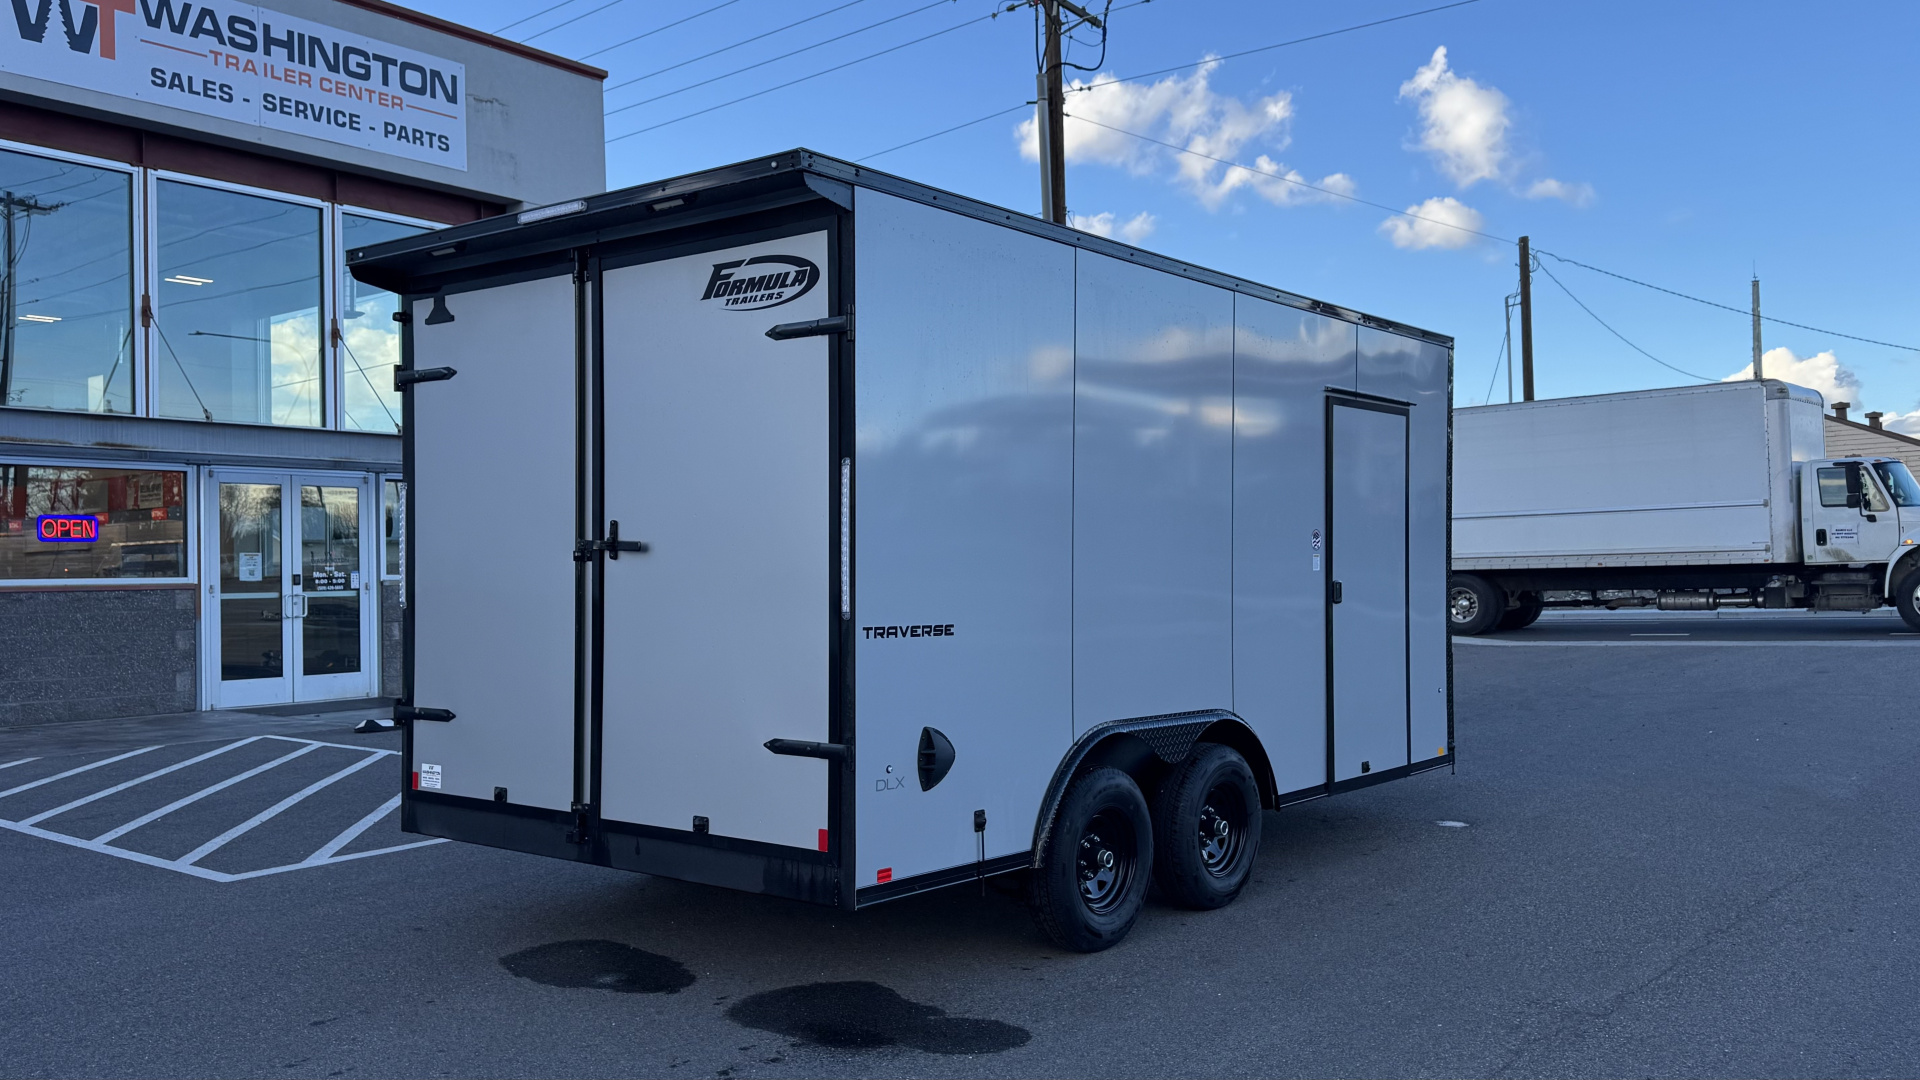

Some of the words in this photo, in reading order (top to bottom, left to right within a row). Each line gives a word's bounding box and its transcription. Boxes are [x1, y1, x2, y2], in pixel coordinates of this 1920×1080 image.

[140, 0, 458, 105] WASHINGTON
[209, 49, 312, 88] TRAILER
[319, 77, 404, 111] CENTER
[150, 67, 234, 103] SALES
[262, 92, 361, 132] SERVICE
[383, 121, 450, 152] PARTS
[700, 259, 809, 300] FORMULA
[725, 291, 785, 306] TRAILERS
[41, 519, 96, 538] OPEN
[862, 624, 955, 639] TRAVERSE
[875, 776, 905, 792] DLX
